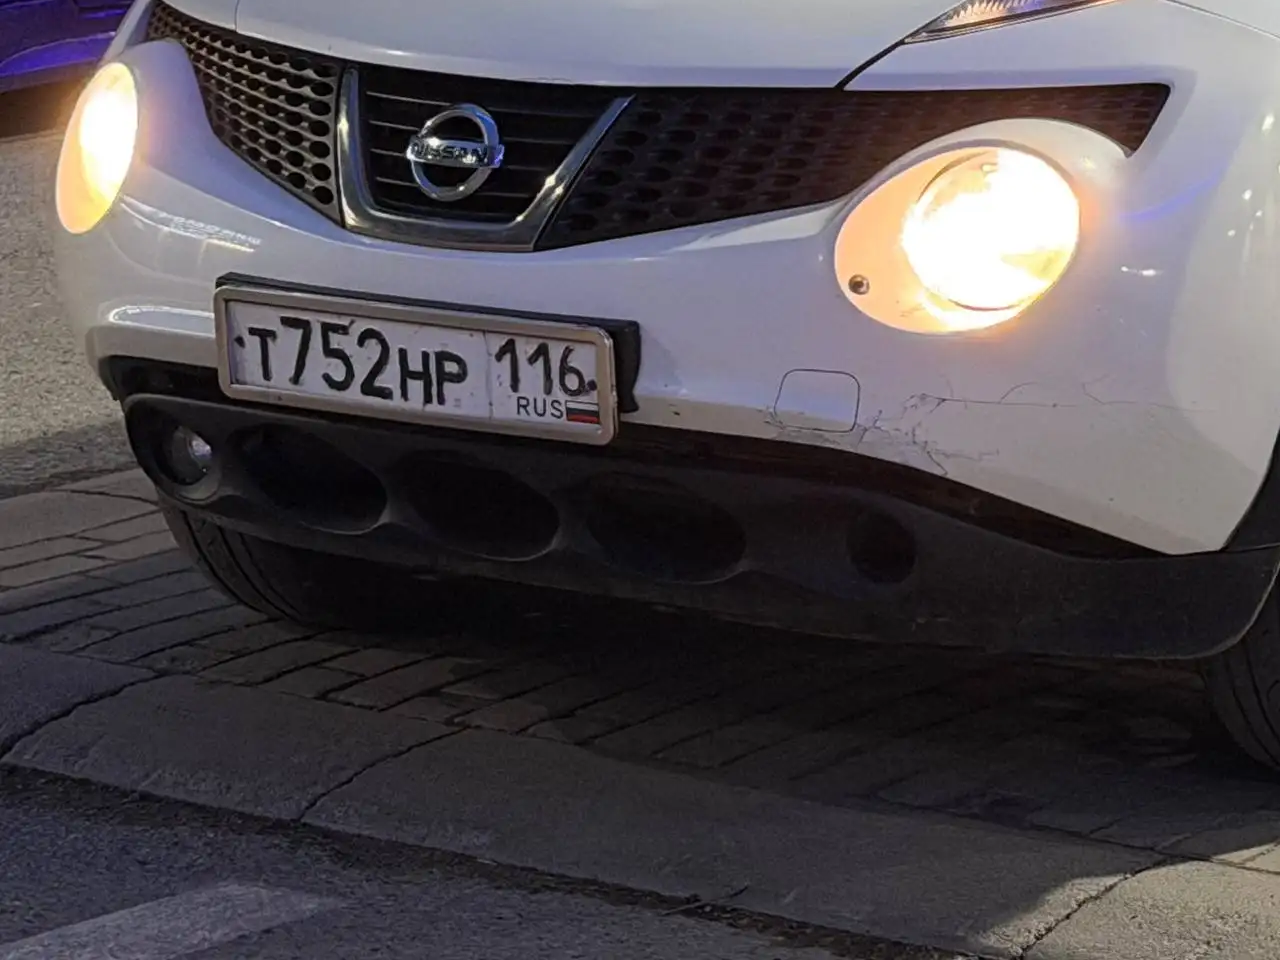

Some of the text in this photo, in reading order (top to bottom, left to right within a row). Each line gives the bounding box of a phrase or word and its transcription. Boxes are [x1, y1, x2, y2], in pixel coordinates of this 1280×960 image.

[408, 140, 490, 166] NISSAN
[247, 315, 586, 406] T752HP 116
[516, 396, 564, 419] RUS
